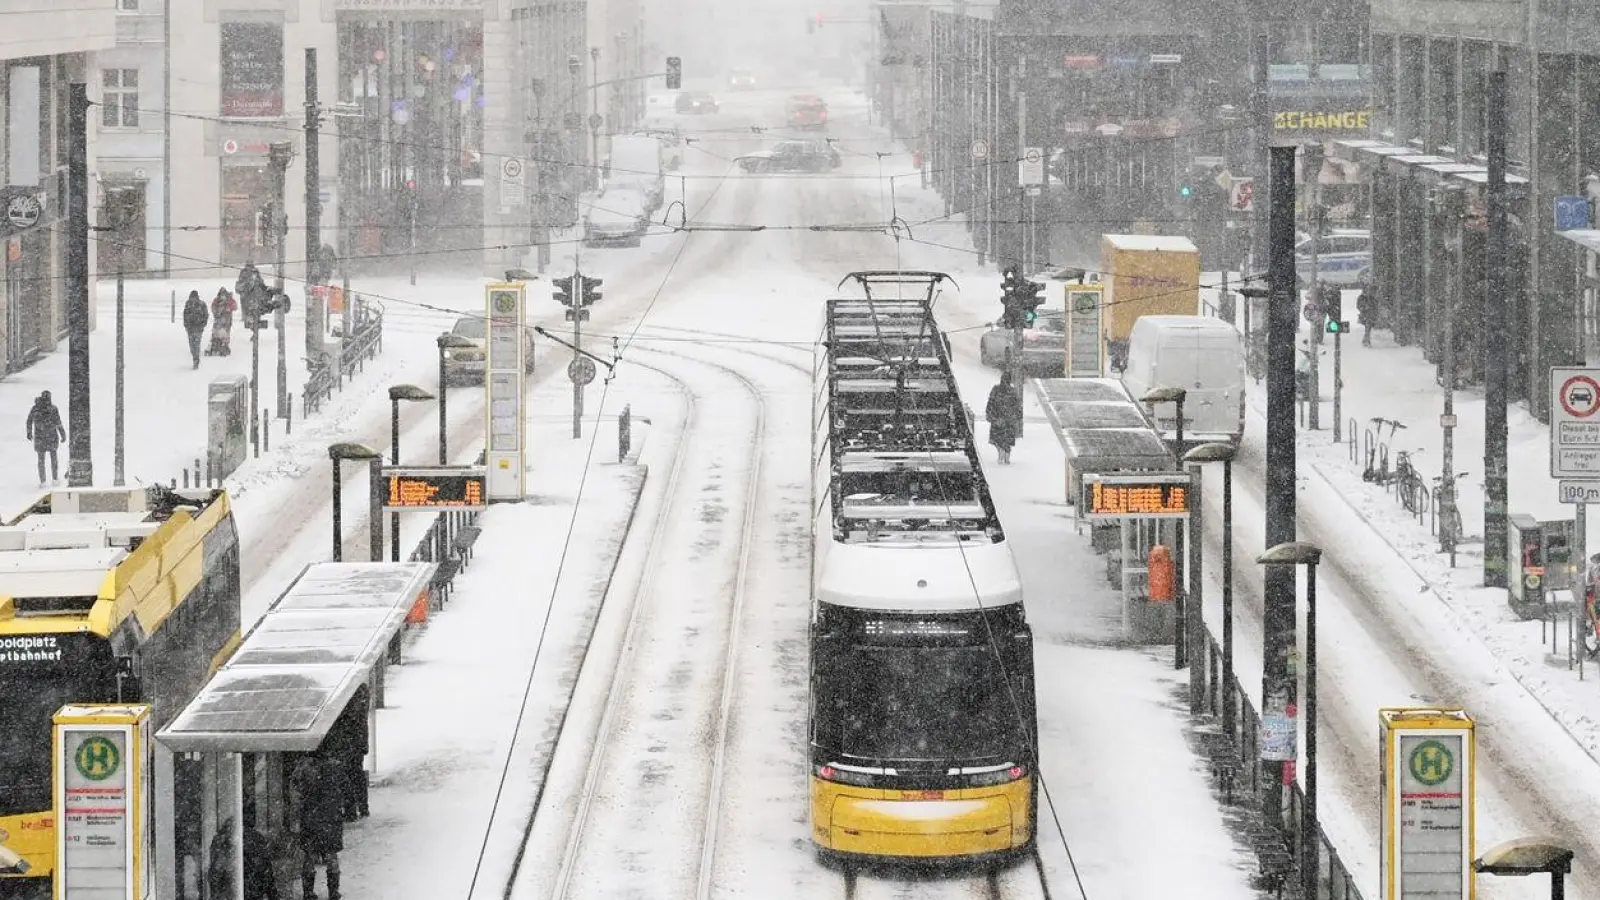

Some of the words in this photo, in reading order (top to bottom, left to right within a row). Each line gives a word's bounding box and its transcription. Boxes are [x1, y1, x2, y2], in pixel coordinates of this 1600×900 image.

[1563, 452, 1597, 461] Anlieger
[1574, 461, 1589, 469] frei
[1564, 486, 1584, 499] 100
[1586, 488, 1600, 499] m
[1420, 751, 1442, 776] H
